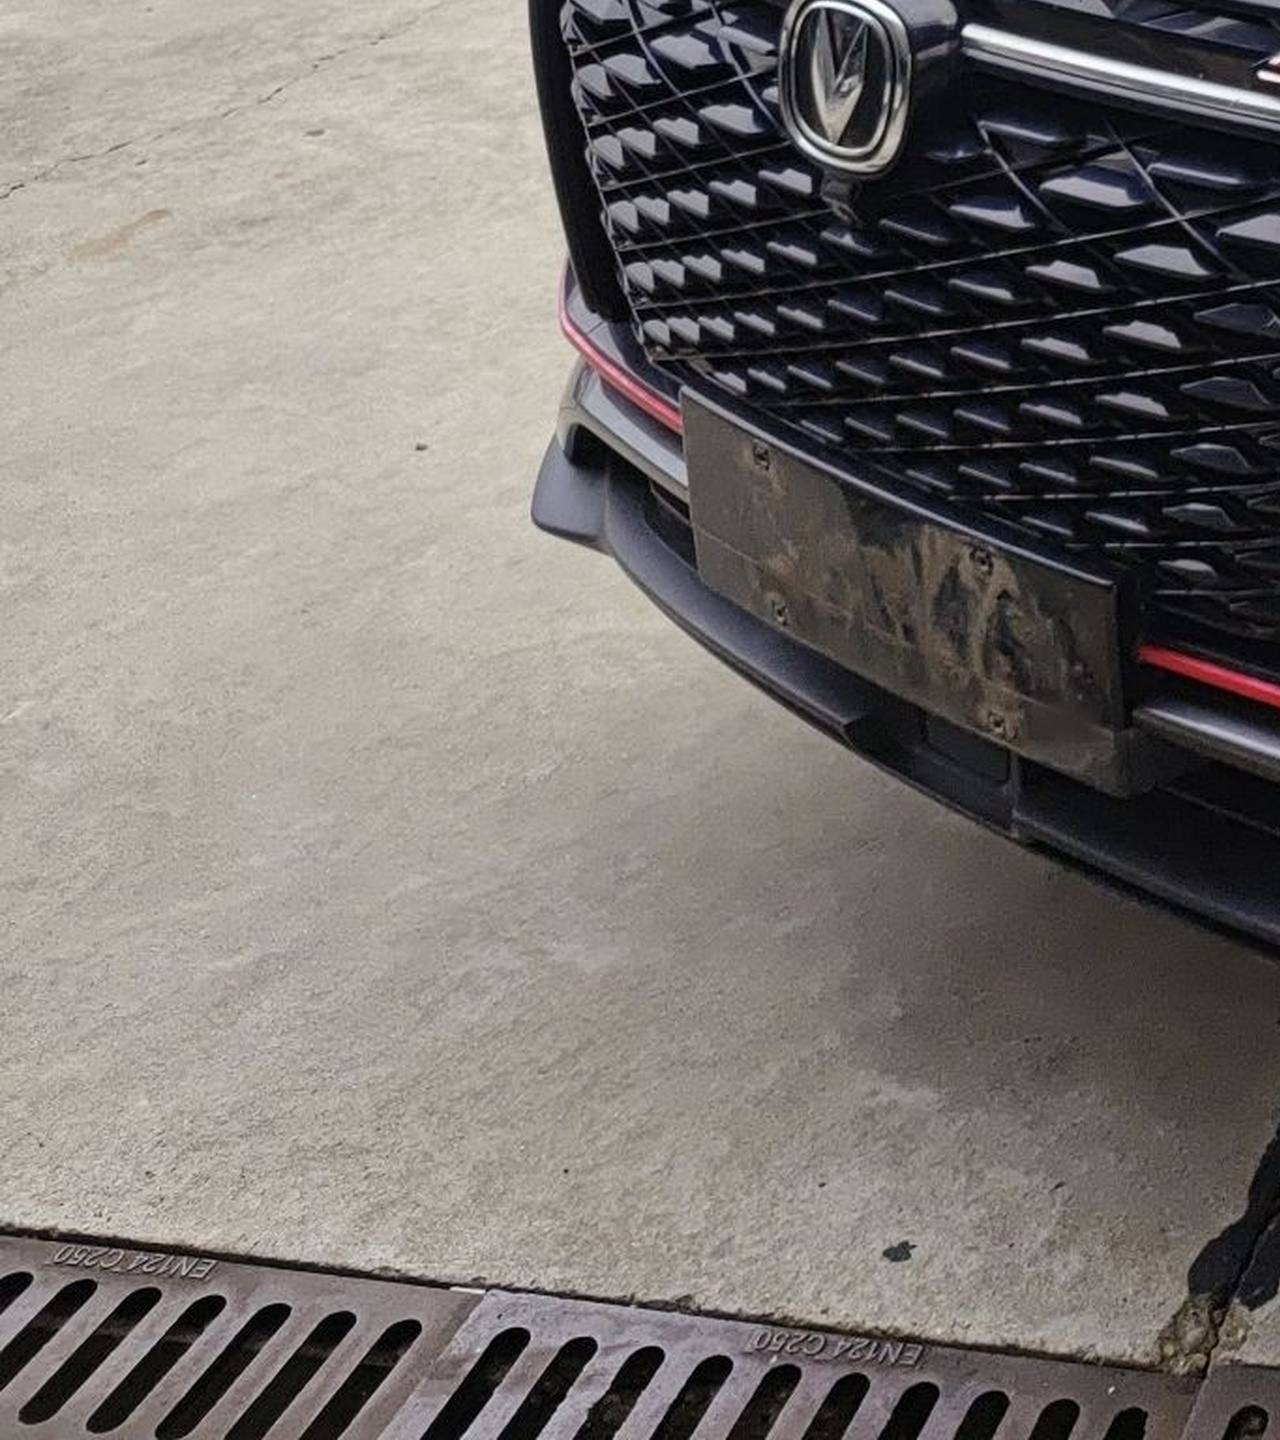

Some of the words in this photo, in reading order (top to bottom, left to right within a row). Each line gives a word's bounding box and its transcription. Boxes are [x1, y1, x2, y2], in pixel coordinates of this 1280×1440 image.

[54, 1244, 125, 1269] C250
[128, 1253, 217, 1279] EN124
[755, 1329, 826, 1356] C250
[834, 1337, 923, 1366] EN124
